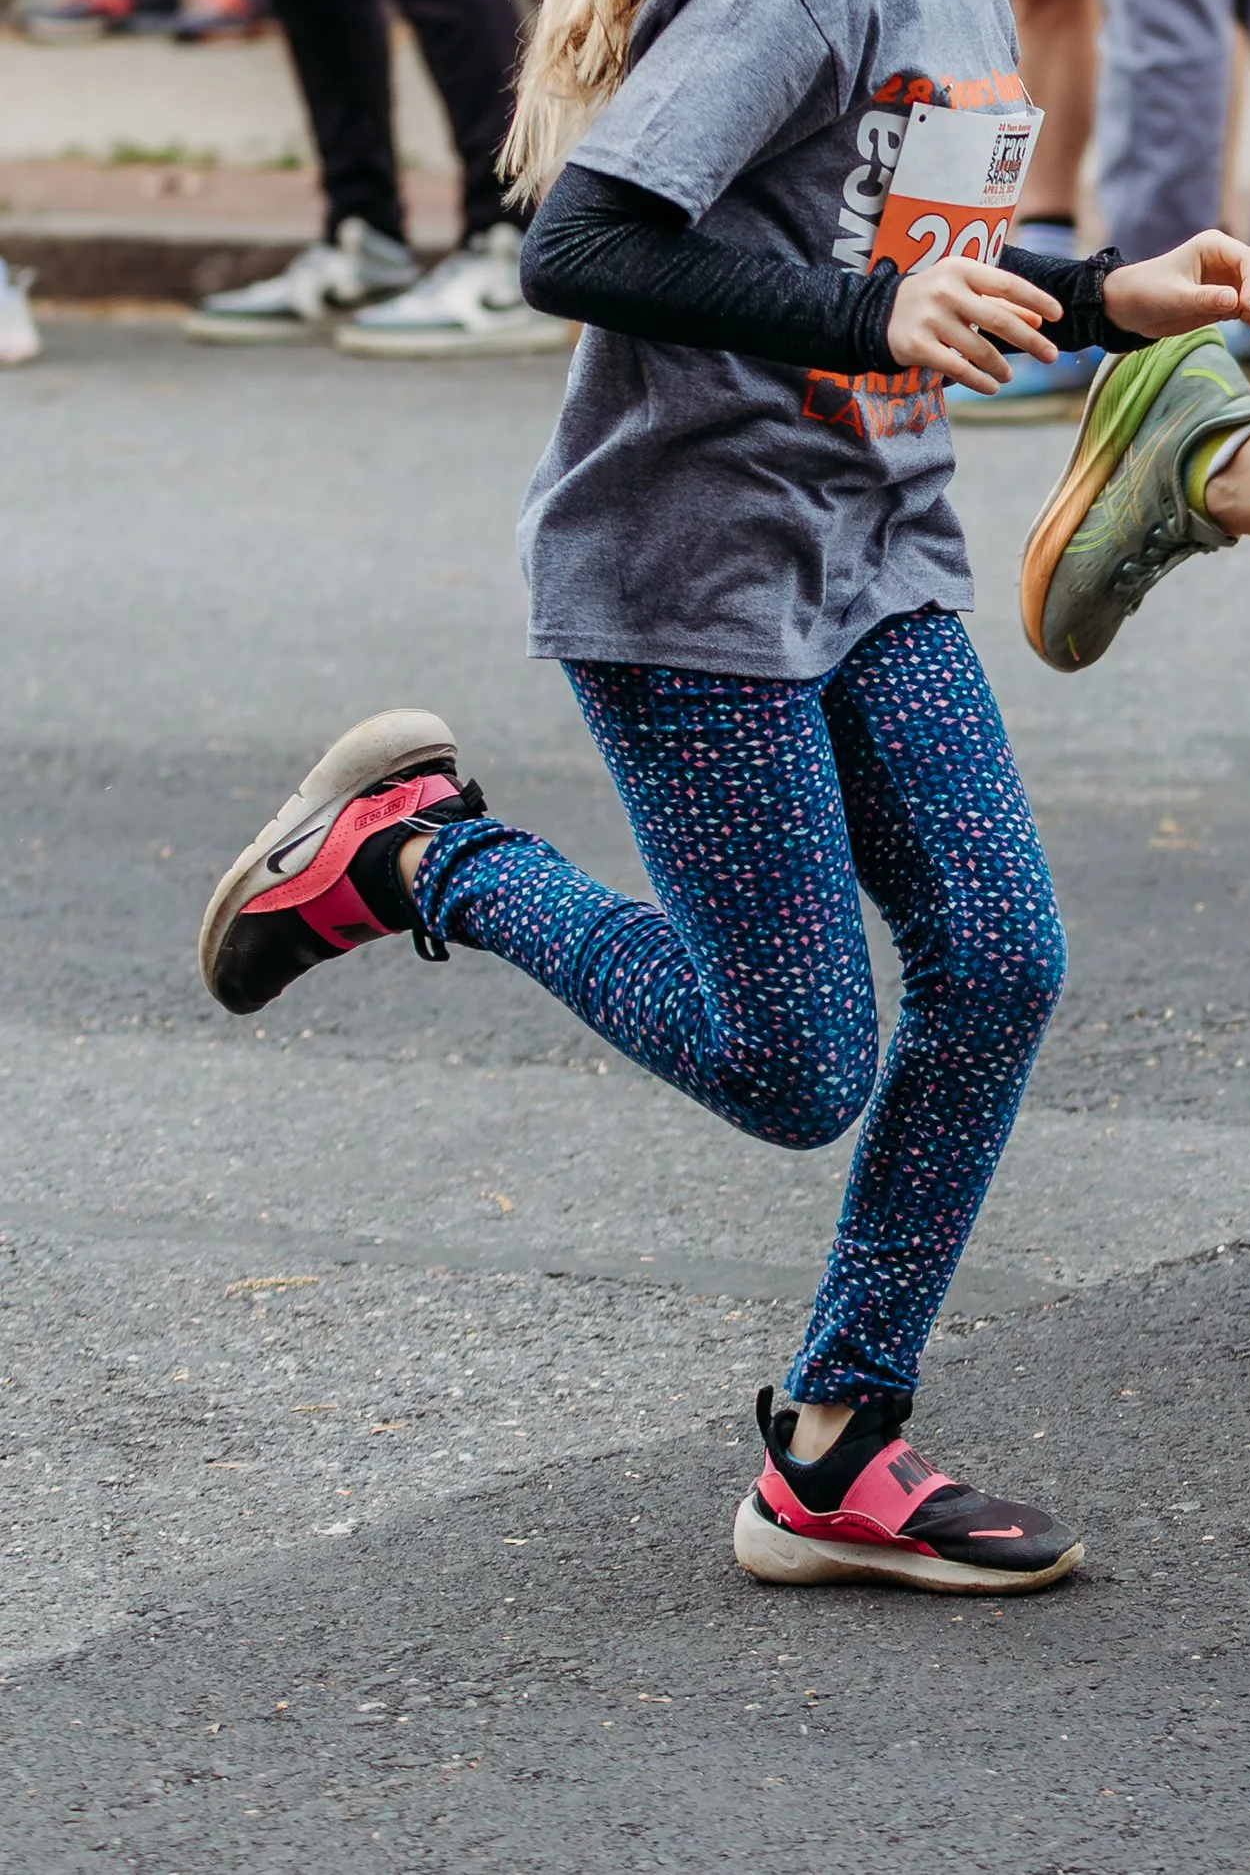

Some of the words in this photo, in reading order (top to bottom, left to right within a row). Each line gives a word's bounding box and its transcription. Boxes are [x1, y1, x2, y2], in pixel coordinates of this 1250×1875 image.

[872, 73, 934, 105] 28
[831, 110, 909, 276] wca
[370, 811, 381, 821] DO
[383, 800, 402, 816] JUST
[359, 816, 368, 826] IT
